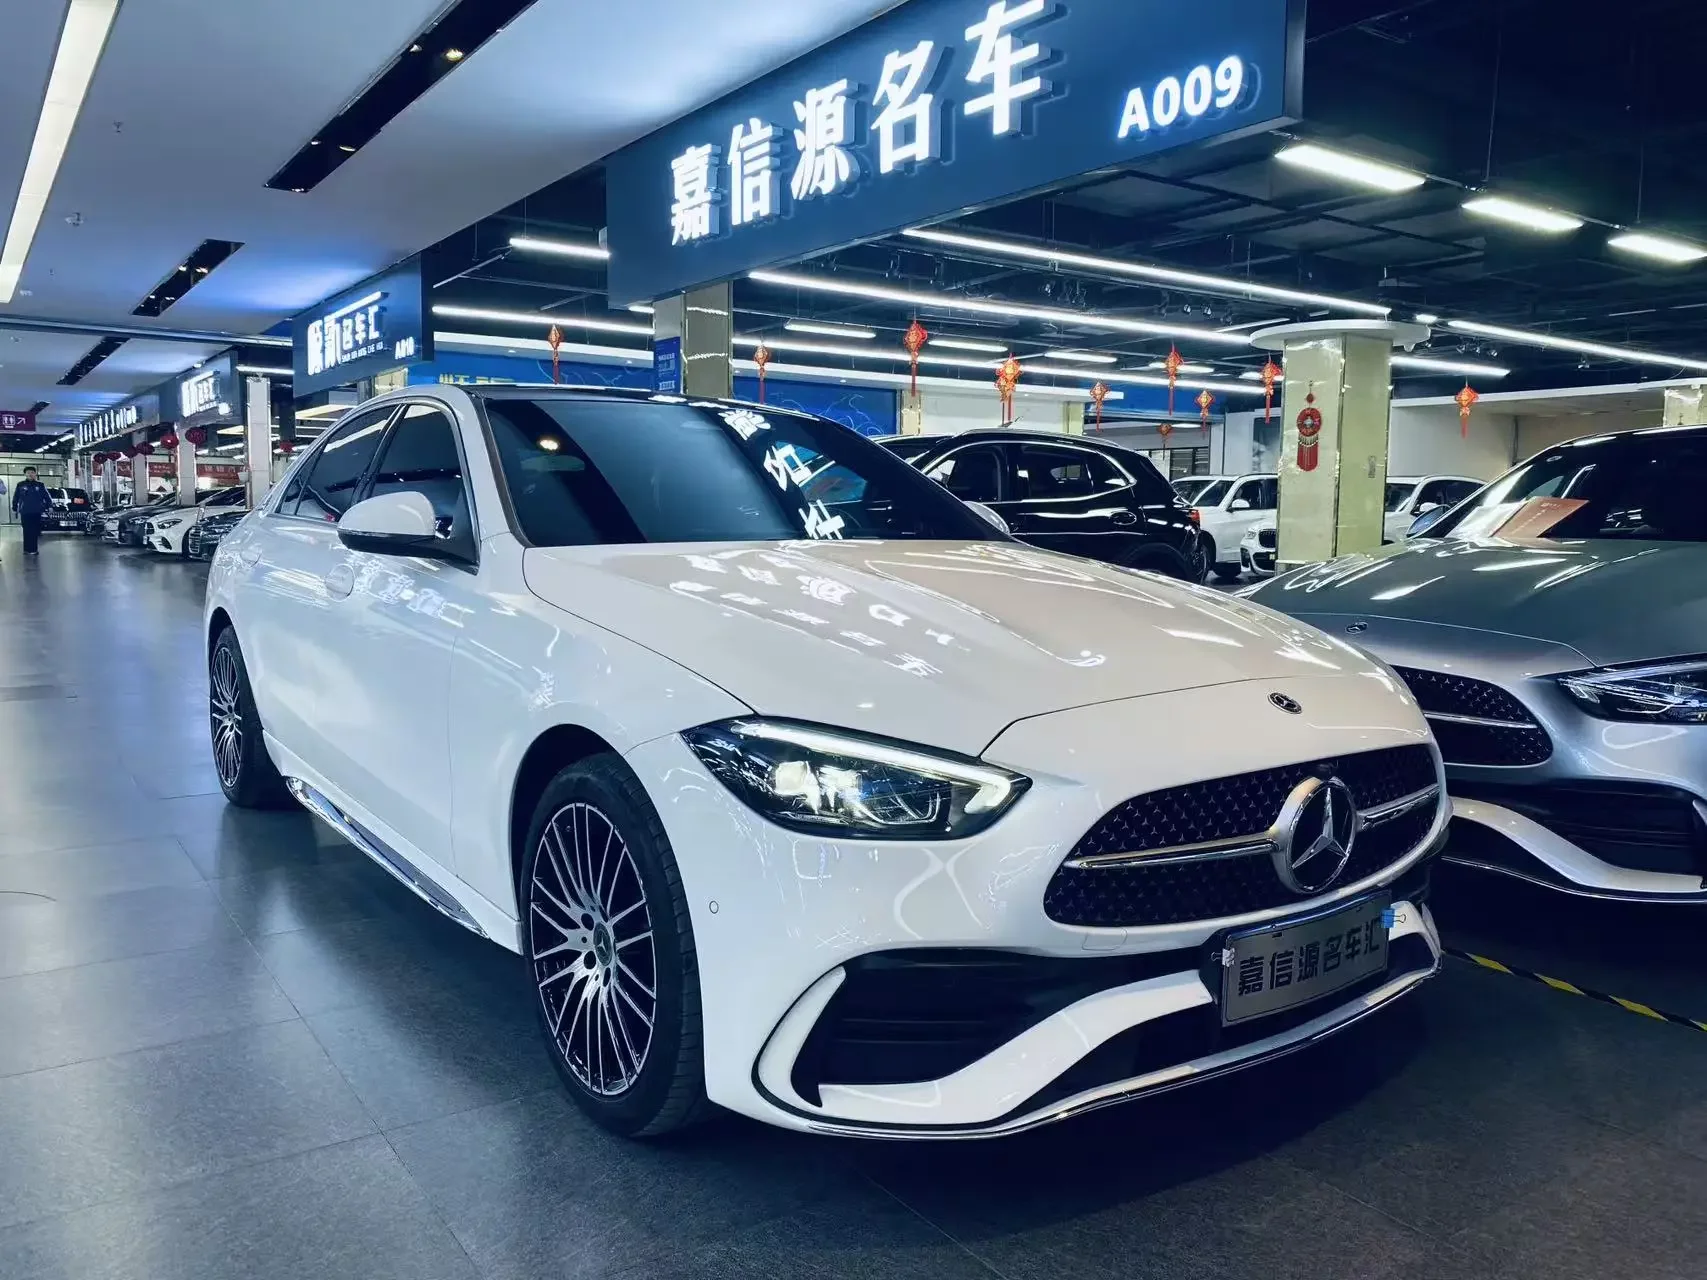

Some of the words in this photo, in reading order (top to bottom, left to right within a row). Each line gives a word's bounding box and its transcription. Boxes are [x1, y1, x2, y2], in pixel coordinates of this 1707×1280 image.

[670, 0, 1048, 246] 嘉信源名车
[1117, 56, 1244, 138] A009
[1238, 916, 1381, 997] 嘉信源名车汇
